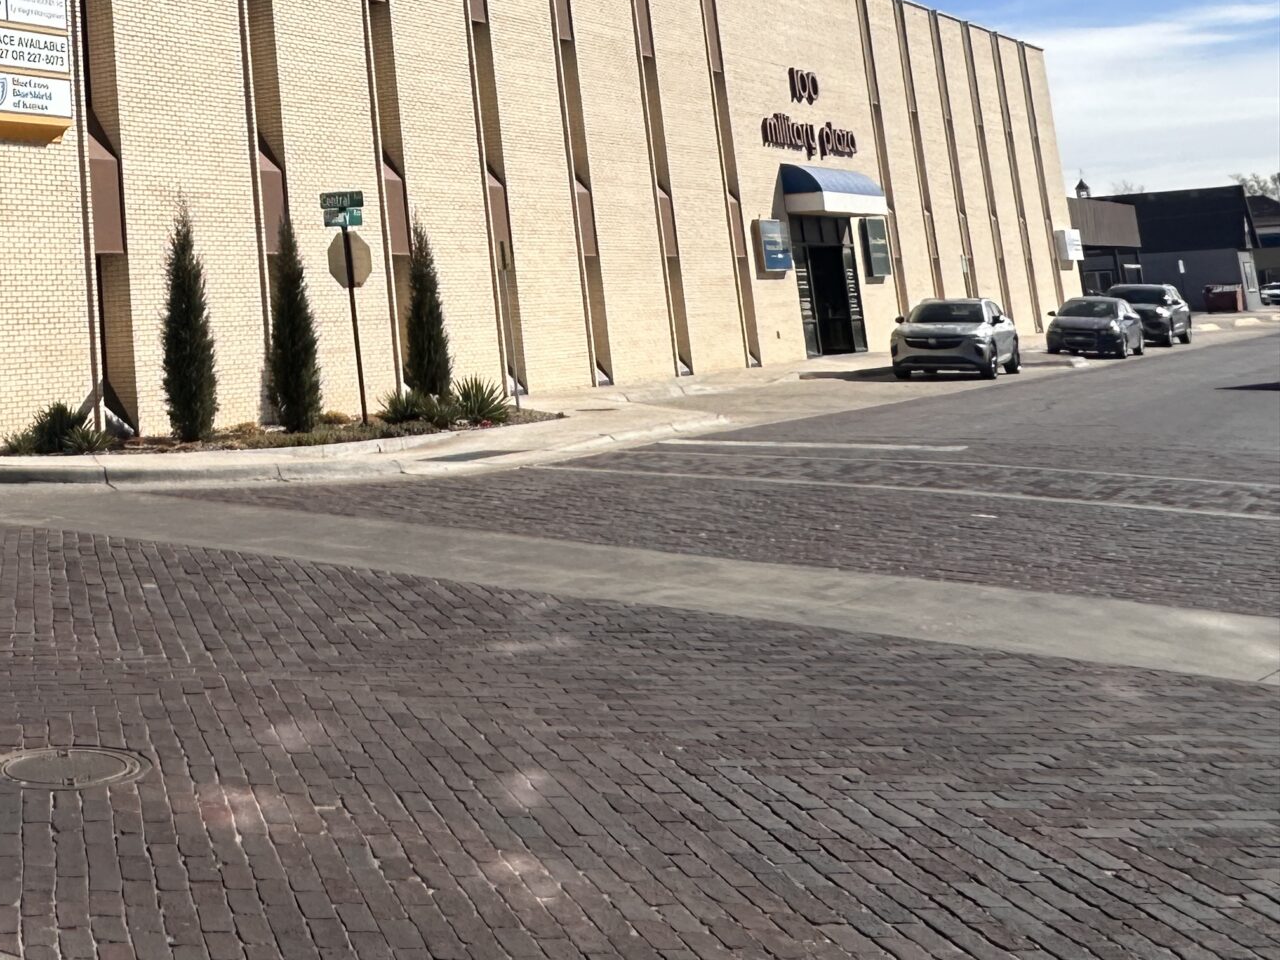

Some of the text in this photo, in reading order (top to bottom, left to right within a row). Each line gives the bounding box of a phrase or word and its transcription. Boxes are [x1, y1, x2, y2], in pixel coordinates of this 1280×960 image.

[18, 37, 66, 52] AVAILABLE
[12, 50, 25, 61] OR
[762, 113, 857, 159] military plaza
